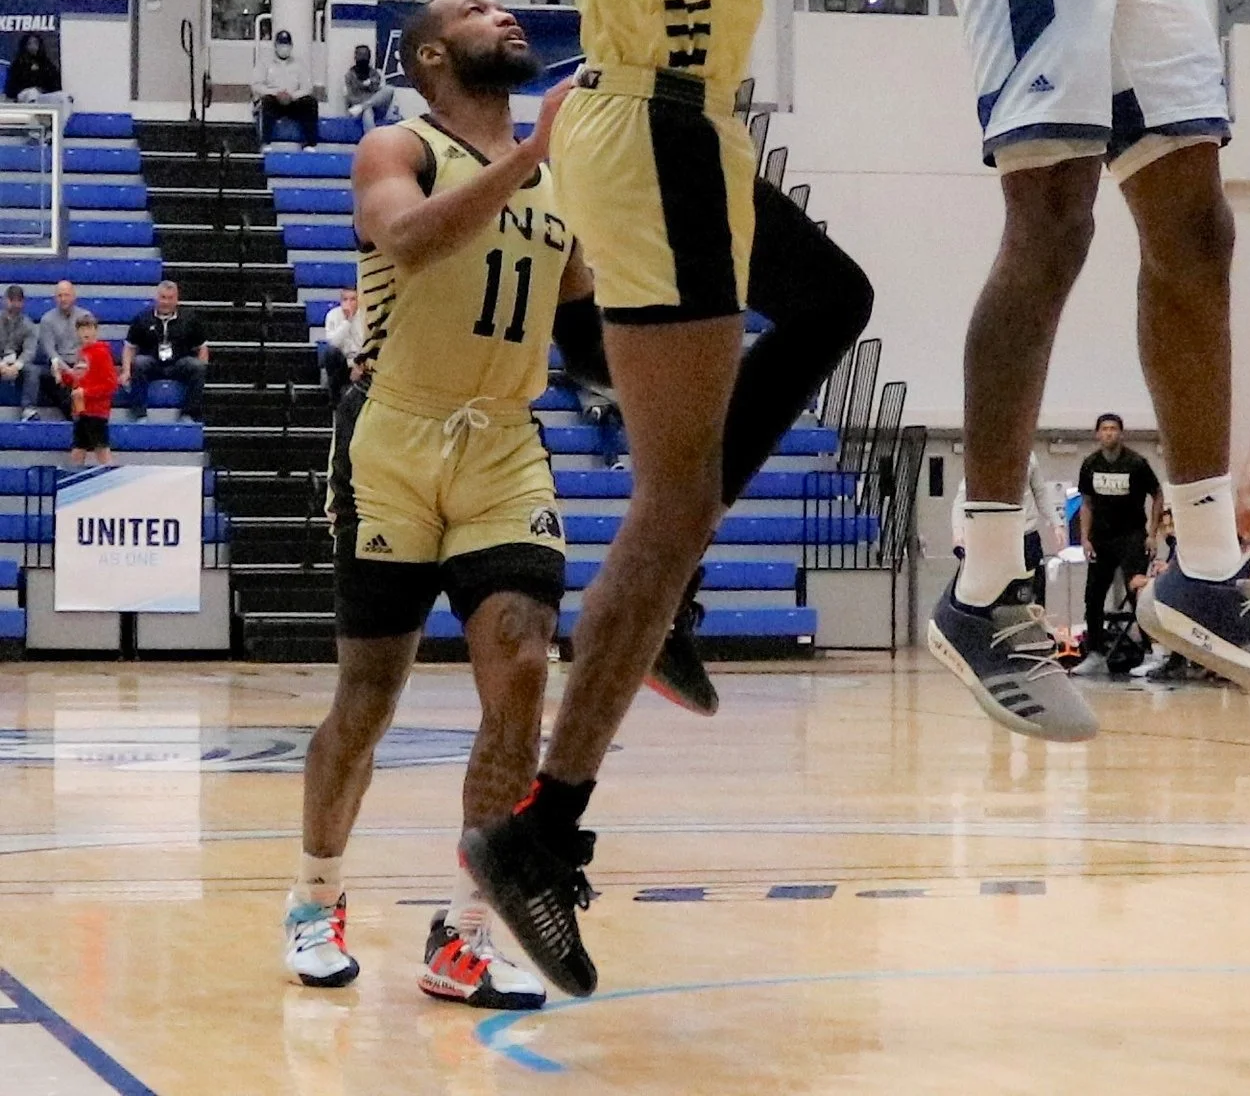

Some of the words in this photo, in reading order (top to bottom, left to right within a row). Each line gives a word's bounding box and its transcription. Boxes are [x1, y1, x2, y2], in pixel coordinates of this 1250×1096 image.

[499, 204, 567, 252] NC
[472, 248, 533, 344] 11
[77, 517, 181, 547] UNITED
